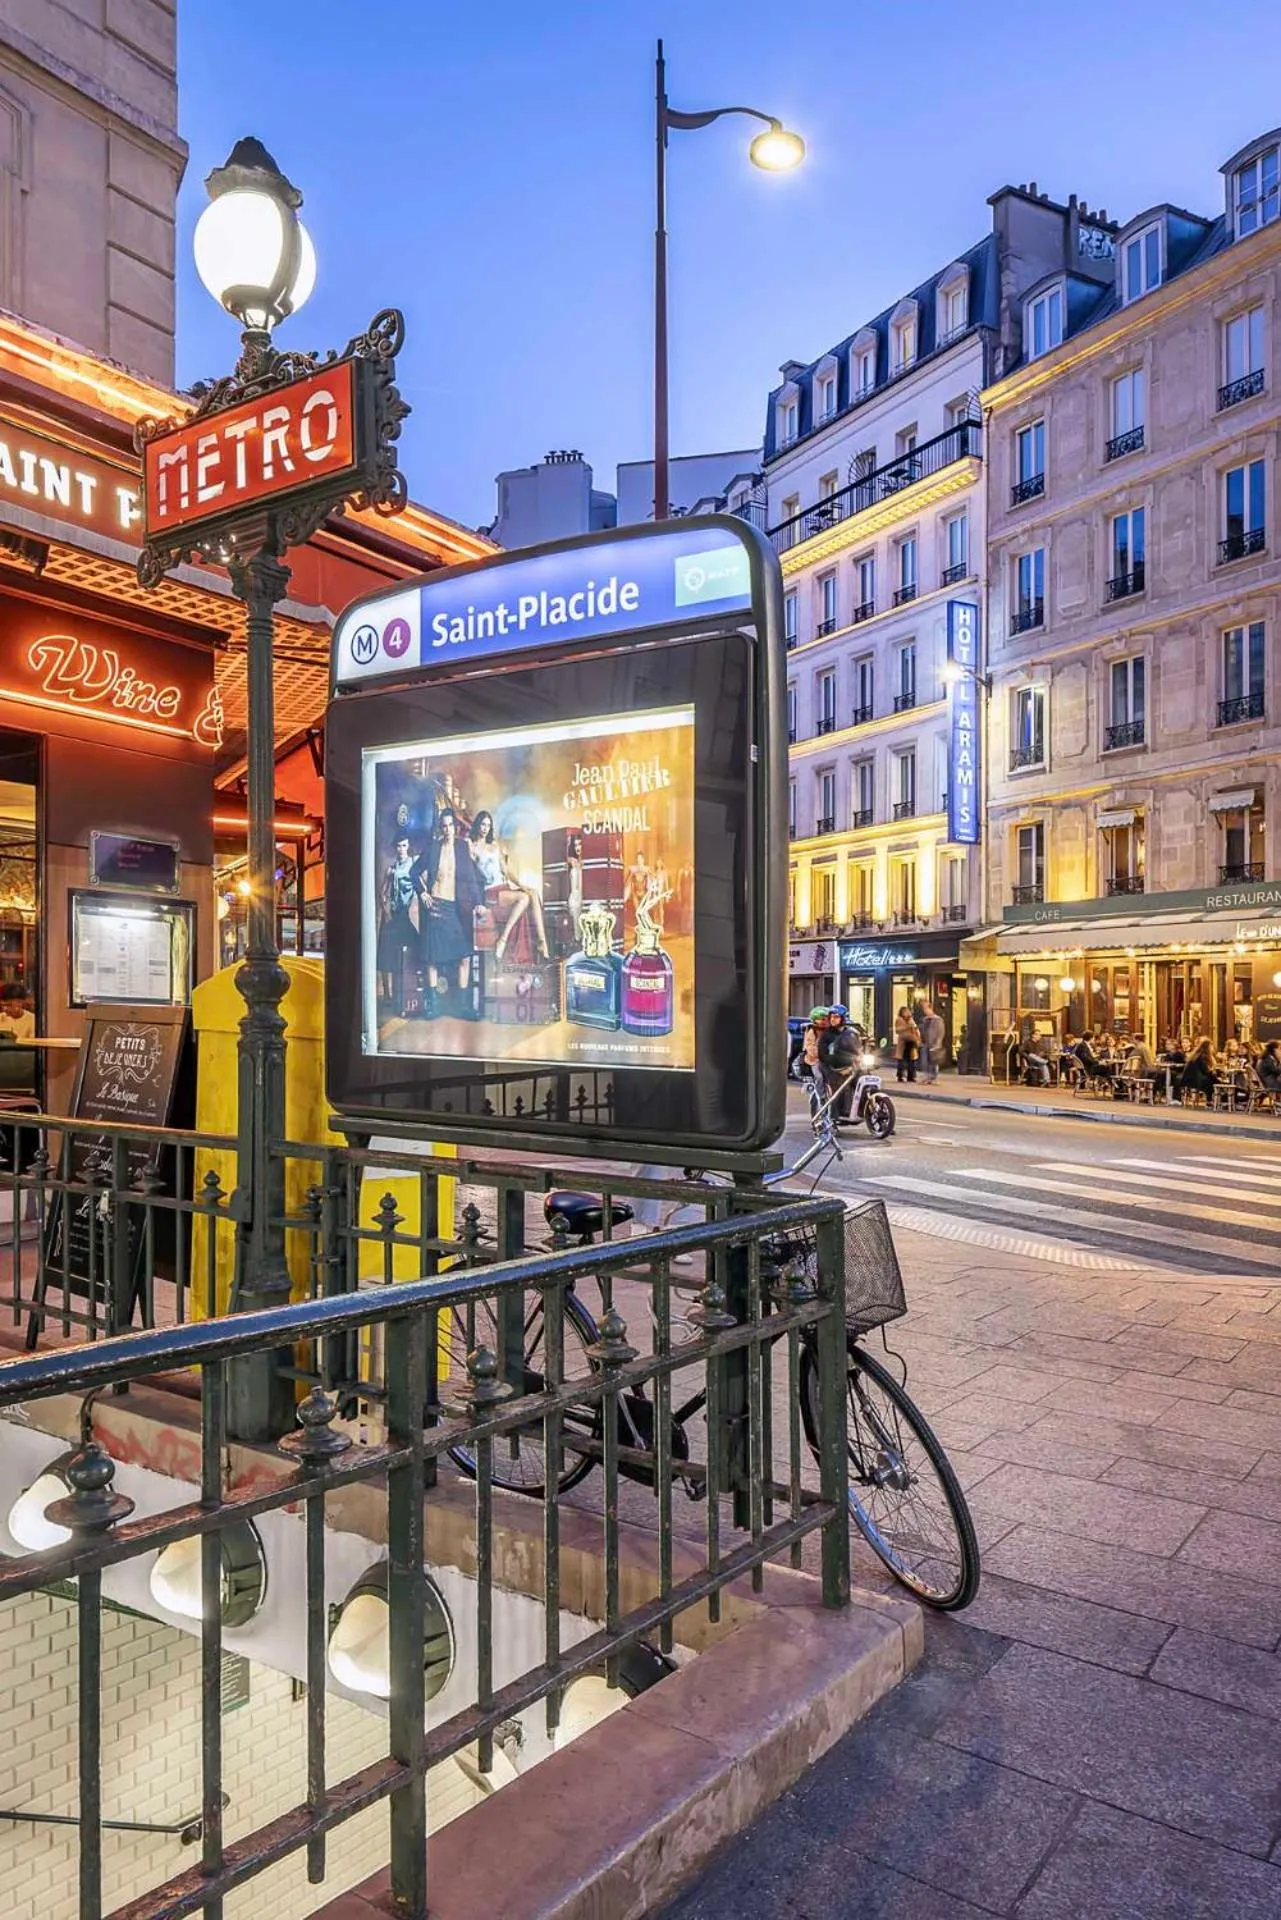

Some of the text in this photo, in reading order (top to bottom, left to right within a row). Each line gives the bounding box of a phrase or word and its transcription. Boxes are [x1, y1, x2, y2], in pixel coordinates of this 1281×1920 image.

[159, 390, 338, 516] METRO
[432, 577, 639, 647] Saint-Placide
[28, 634, 181, 717] Wine
[572, 763, 614, 786] Jean
[958, 711, 973, 824] ARAMIS
[583, 804, 651, 835] SCANDAL
[115, 1037, 146, 1051] PETITS
